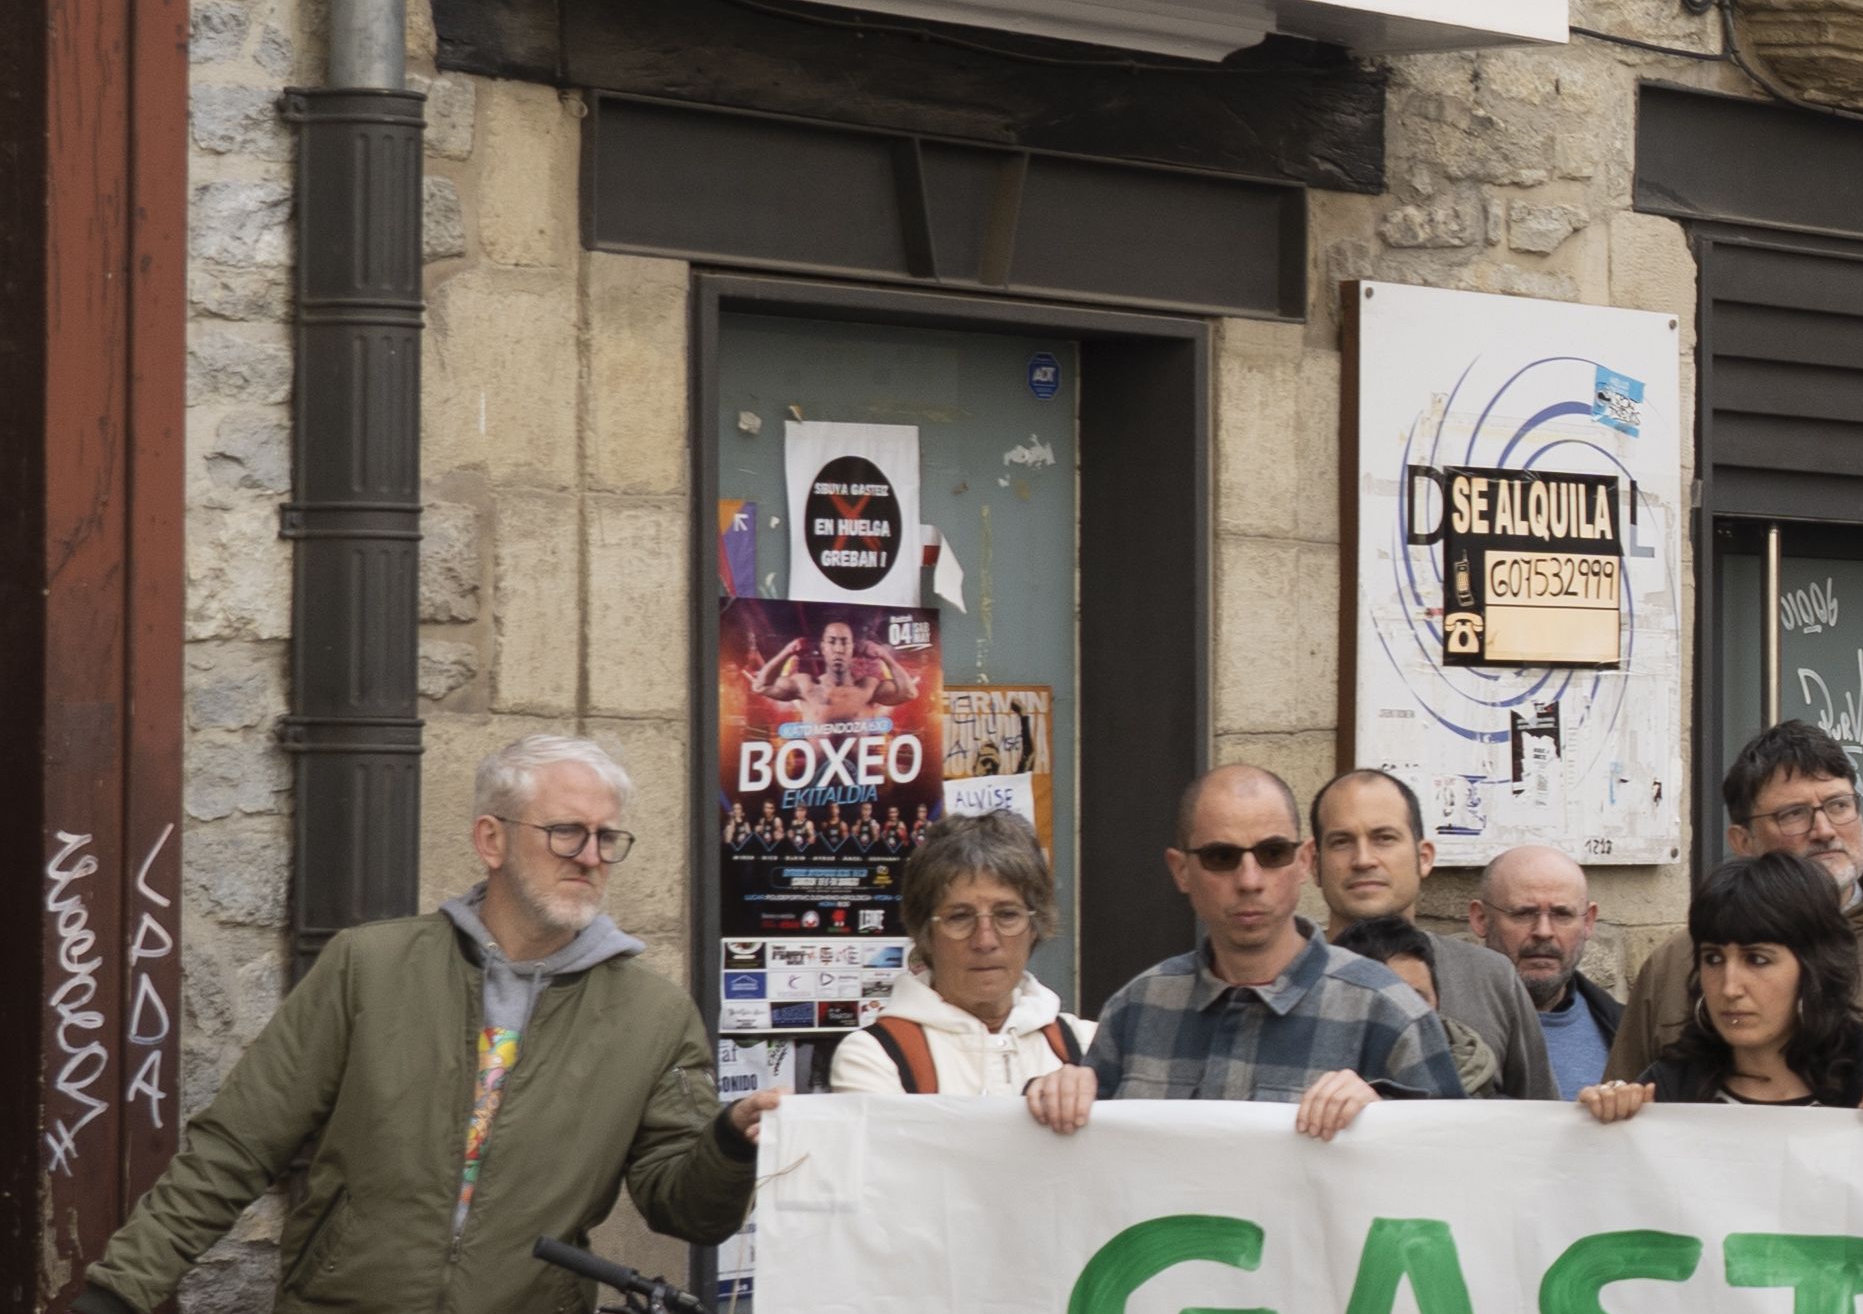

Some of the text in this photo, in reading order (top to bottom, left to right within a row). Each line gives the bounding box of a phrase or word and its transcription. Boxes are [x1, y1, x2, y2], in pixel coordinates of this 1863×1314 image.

[851, 484, 889, 497] GASTEIZ
[1452, 475, 1614, 542] SE ALQUILA
[815, 519, 891, 537] EN HUELGA
[821, 550, 877, 567] GREBAN
[1490, 557, 1615, 600] 607532999
[889, 623, 912, 645] 04
[738, 734, 923, 793] BOXEO
[782, 785, 878, 810] EKITALDIA
